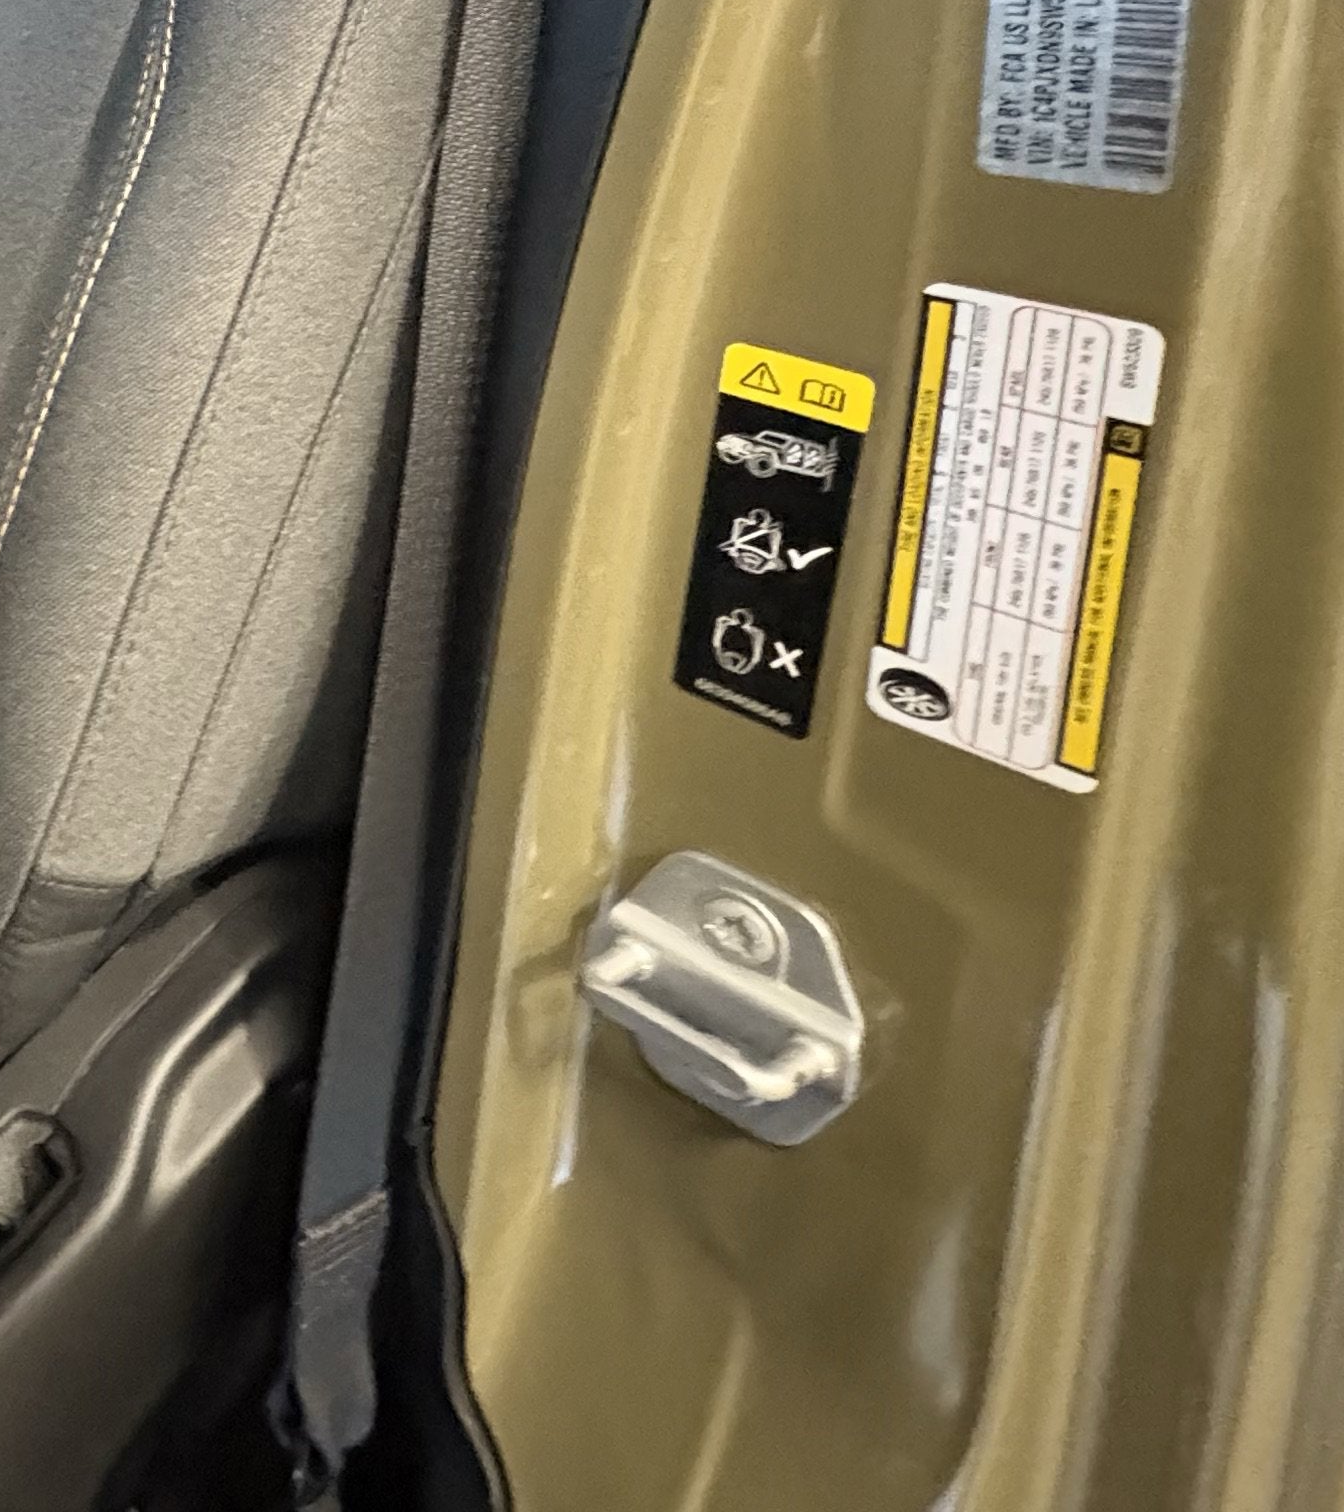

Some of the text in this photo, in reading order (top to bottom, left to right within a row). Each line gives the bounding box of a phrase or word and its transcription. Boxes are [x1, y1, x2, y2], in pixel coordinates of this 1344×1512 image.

[1001, 22, 1029, 46] US
[999, 52, 1026, 83] FCA
[1066, 43, 1097, 94] MADE
[993, 122, 1021, 161] MFD
[1060, 99, 1092, 171] VEHICLE
